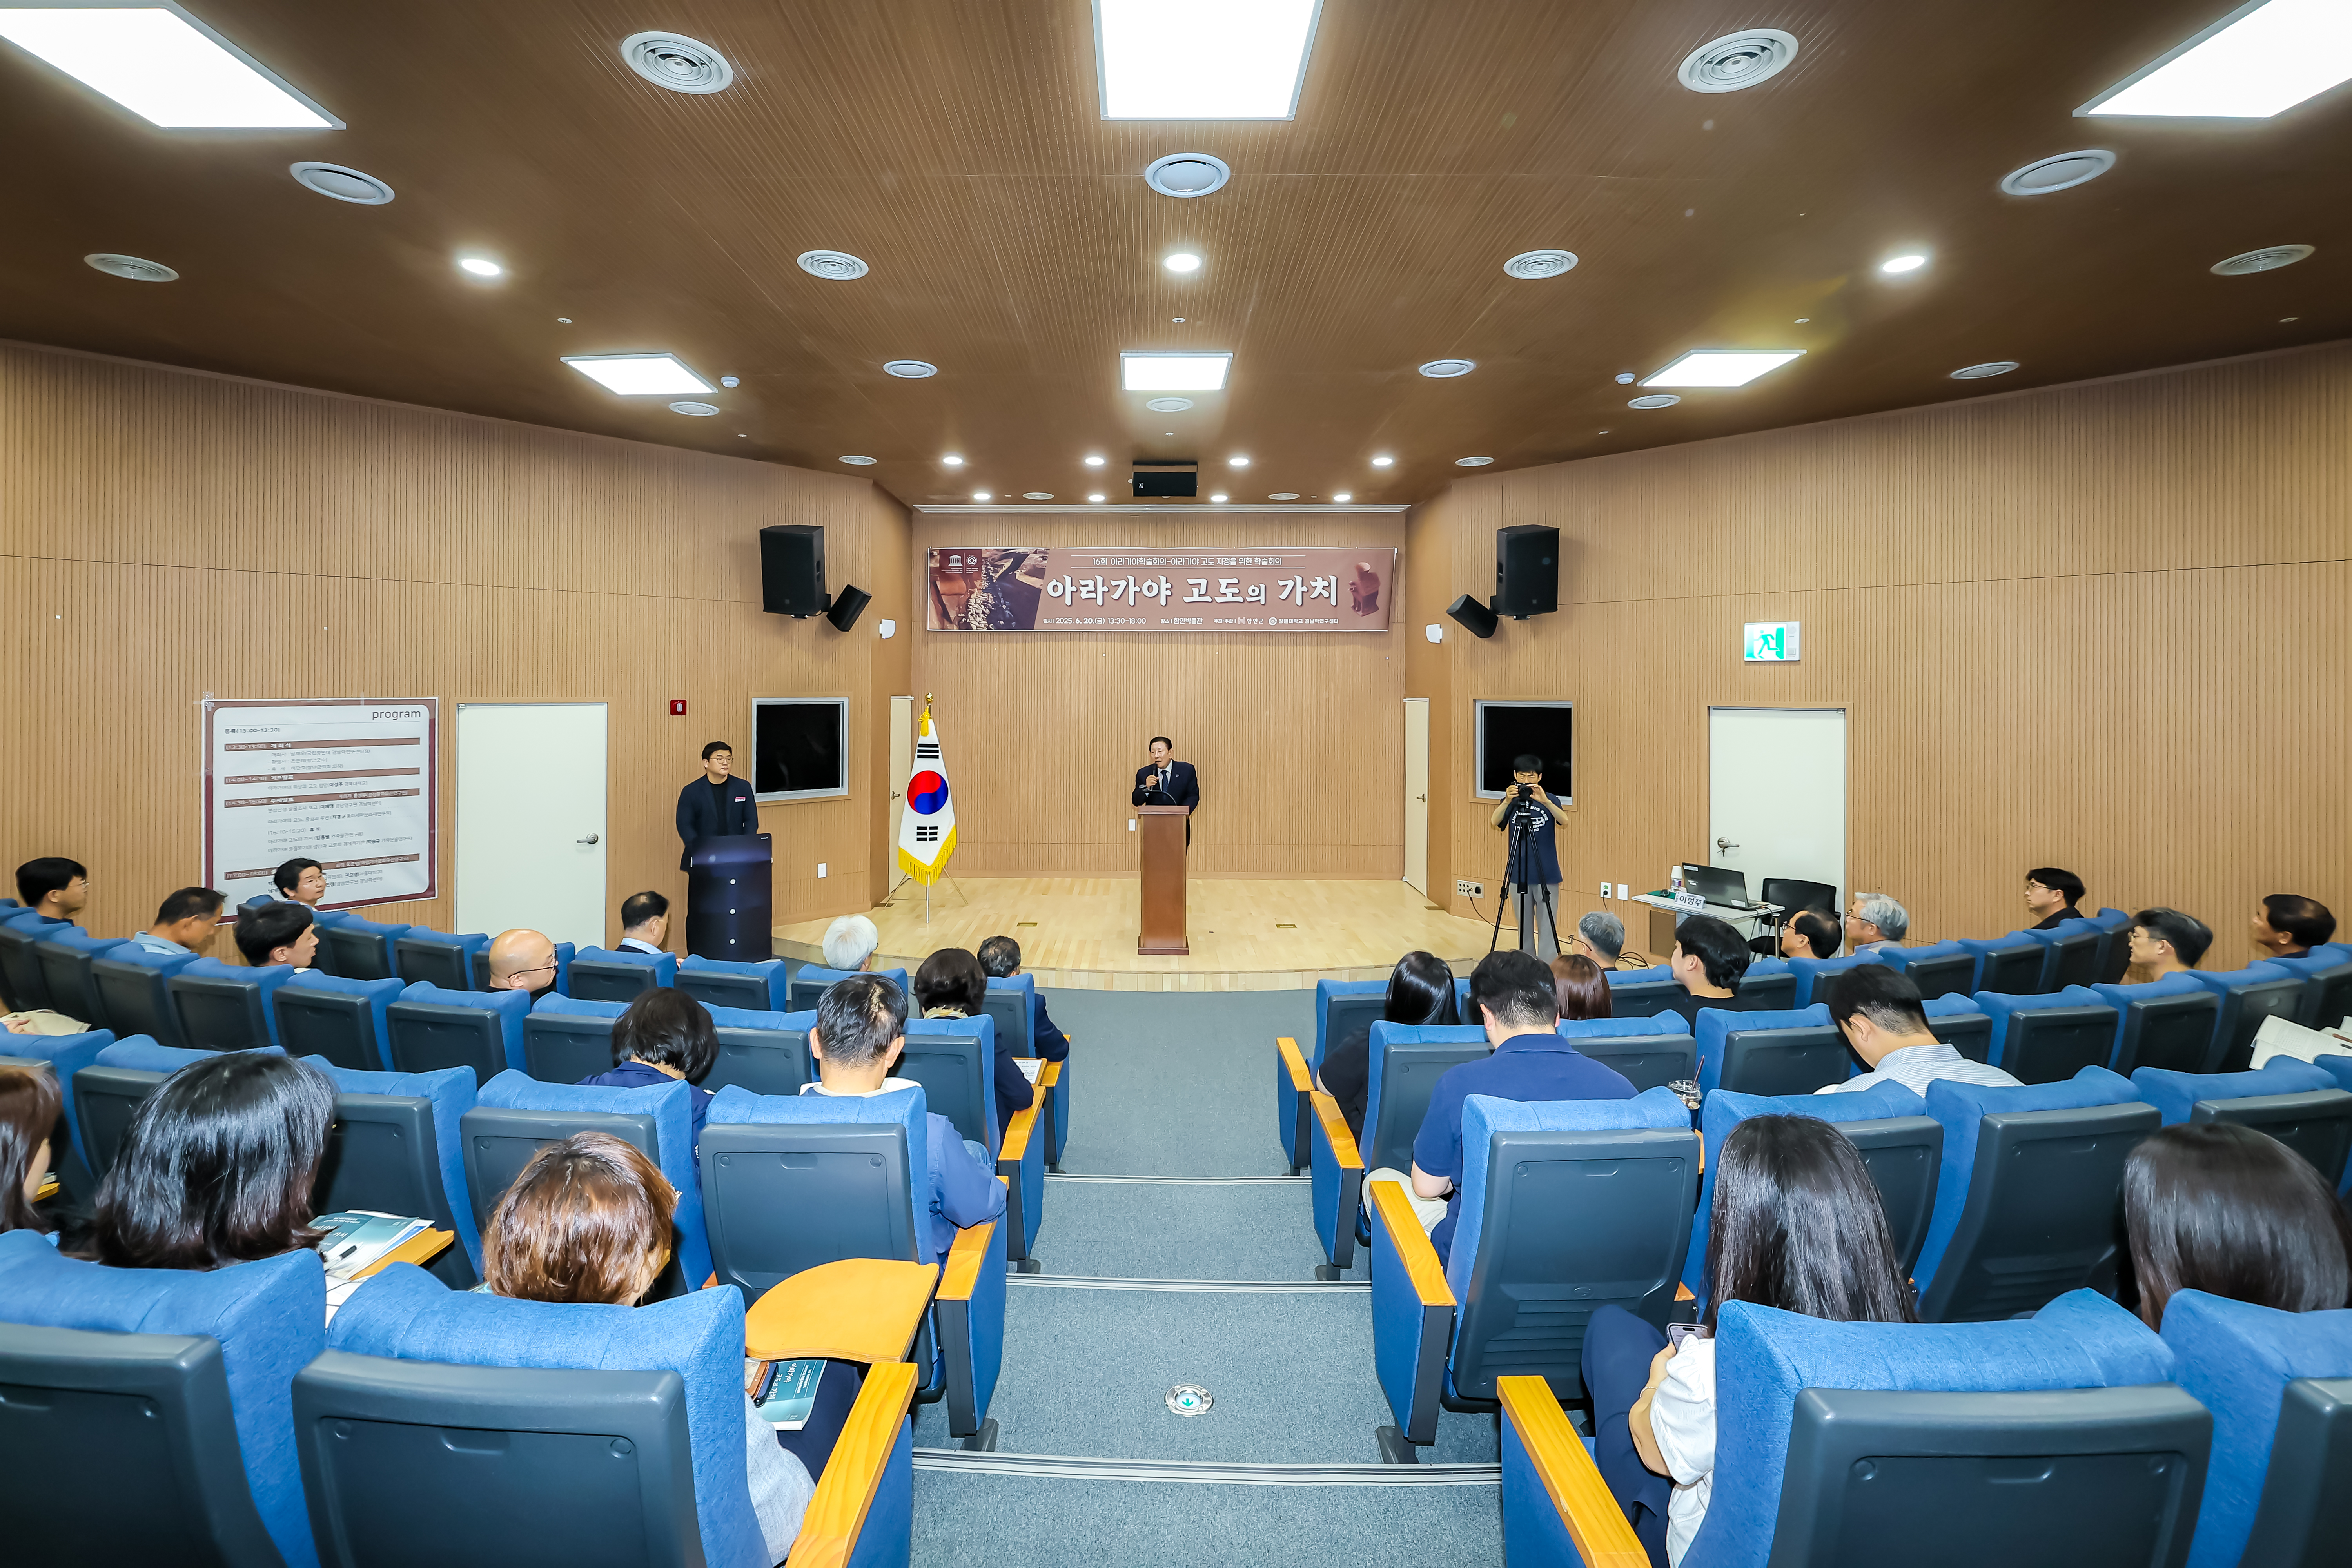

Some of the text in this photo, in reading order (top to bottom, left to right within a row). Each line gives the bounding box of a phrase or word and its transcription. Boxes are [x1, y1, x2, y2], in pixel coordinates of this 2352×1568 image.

[1047, 575, 1338, 606] 아라가야 고도의 가치
[372, 711, 421, 720] program
[1679, 895, 1702, 906] 이성주
[783, 1363, 797, 1383] 아라가야
